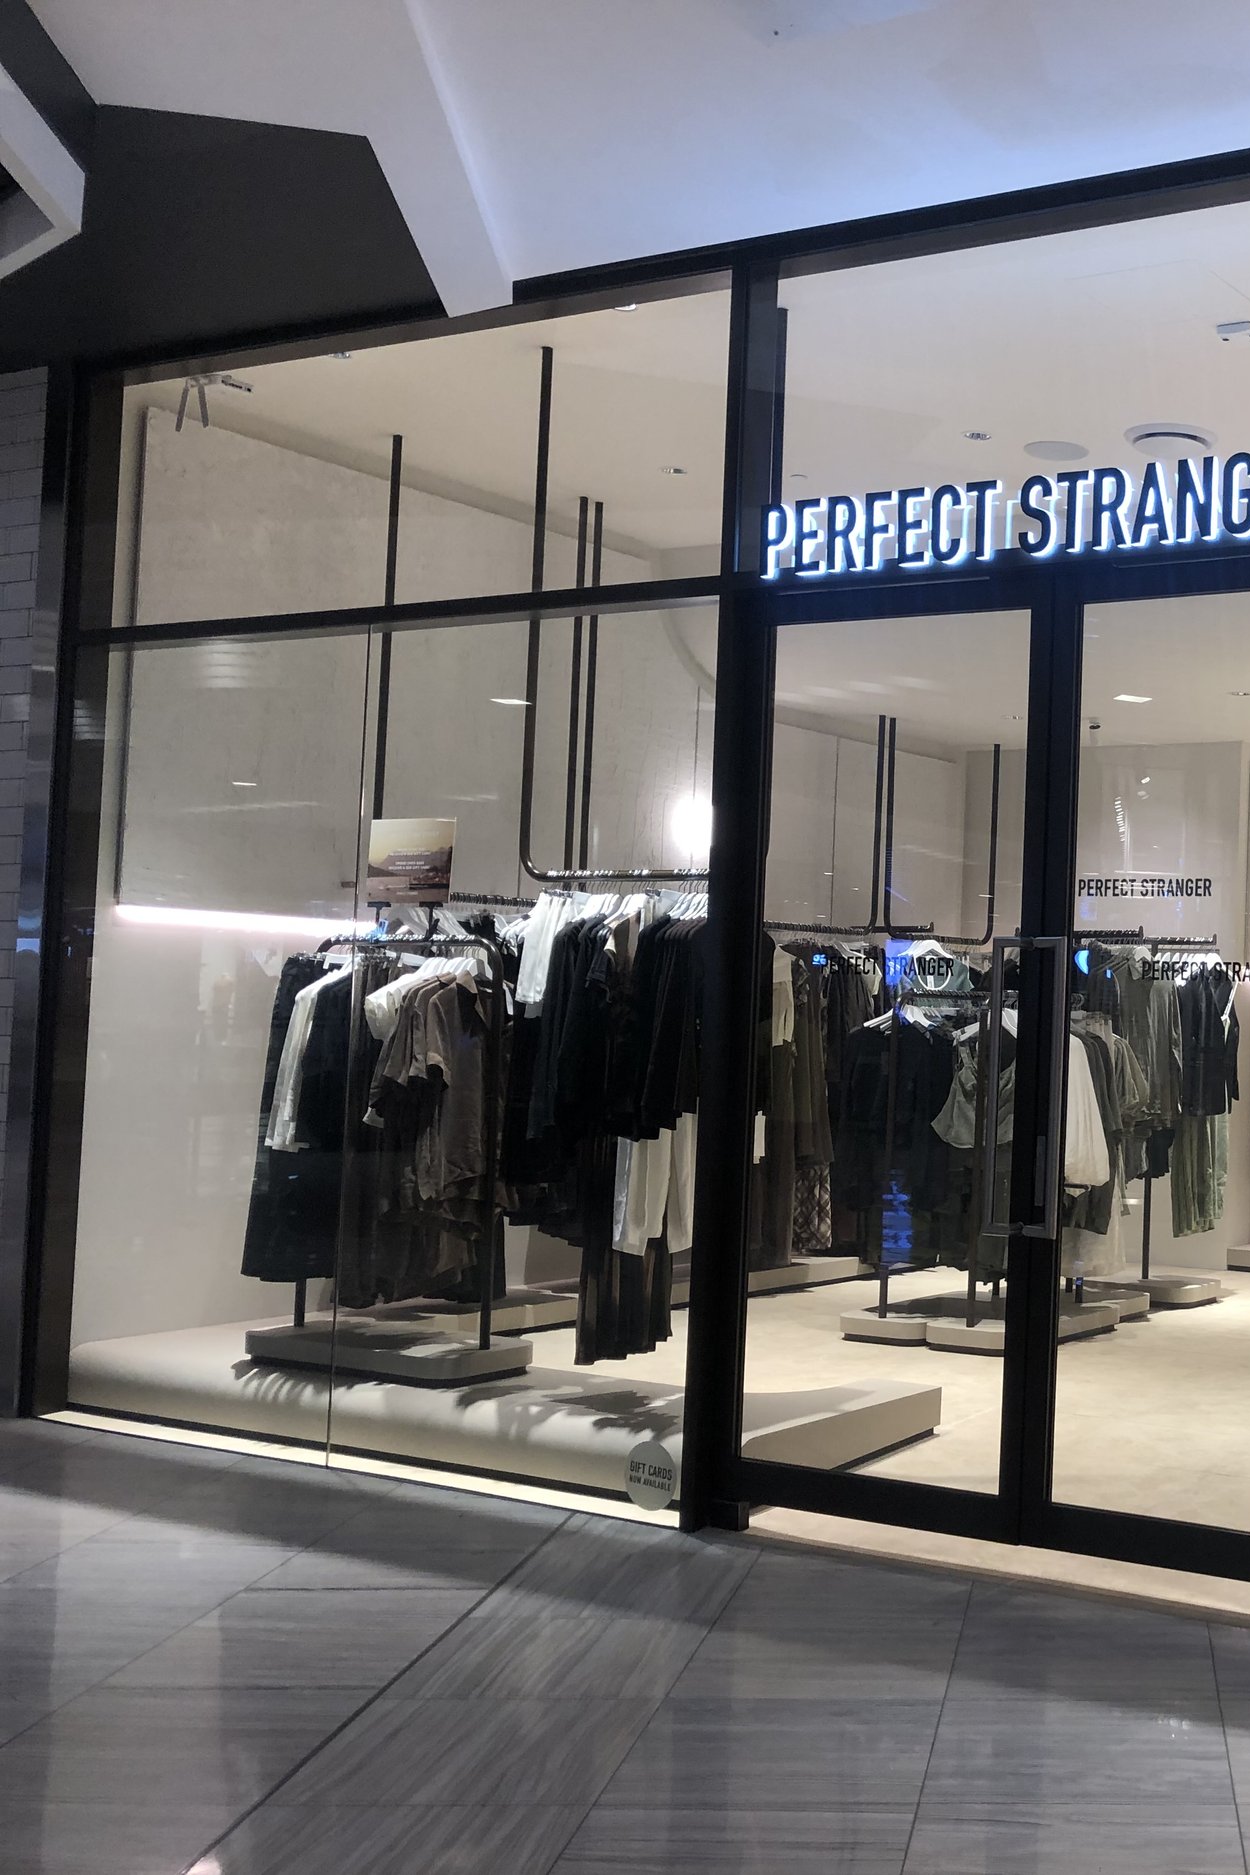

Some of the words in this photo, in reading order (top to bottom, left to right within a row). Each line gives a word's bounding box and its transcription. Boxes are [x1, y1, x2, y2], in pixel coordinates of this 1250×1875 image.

[759, 480, 1002, 579] PERFECT
[1078, 878, 1136, 897] PERFECT
[1140, 878, 1212, 897] STRANGER
[820, 956, 878, 976] PERFECT
[883, 956, 954, 976] STRANGER
[1142, 961, 1207, 981] PERFECT
[630, 1460, 646, 1474] GIFT
[648, 1465, 672, 1480] CARDS
[629, 1474, 641, 1484] NOW
[643, 1477, 671, 1491] AVAILABLE
